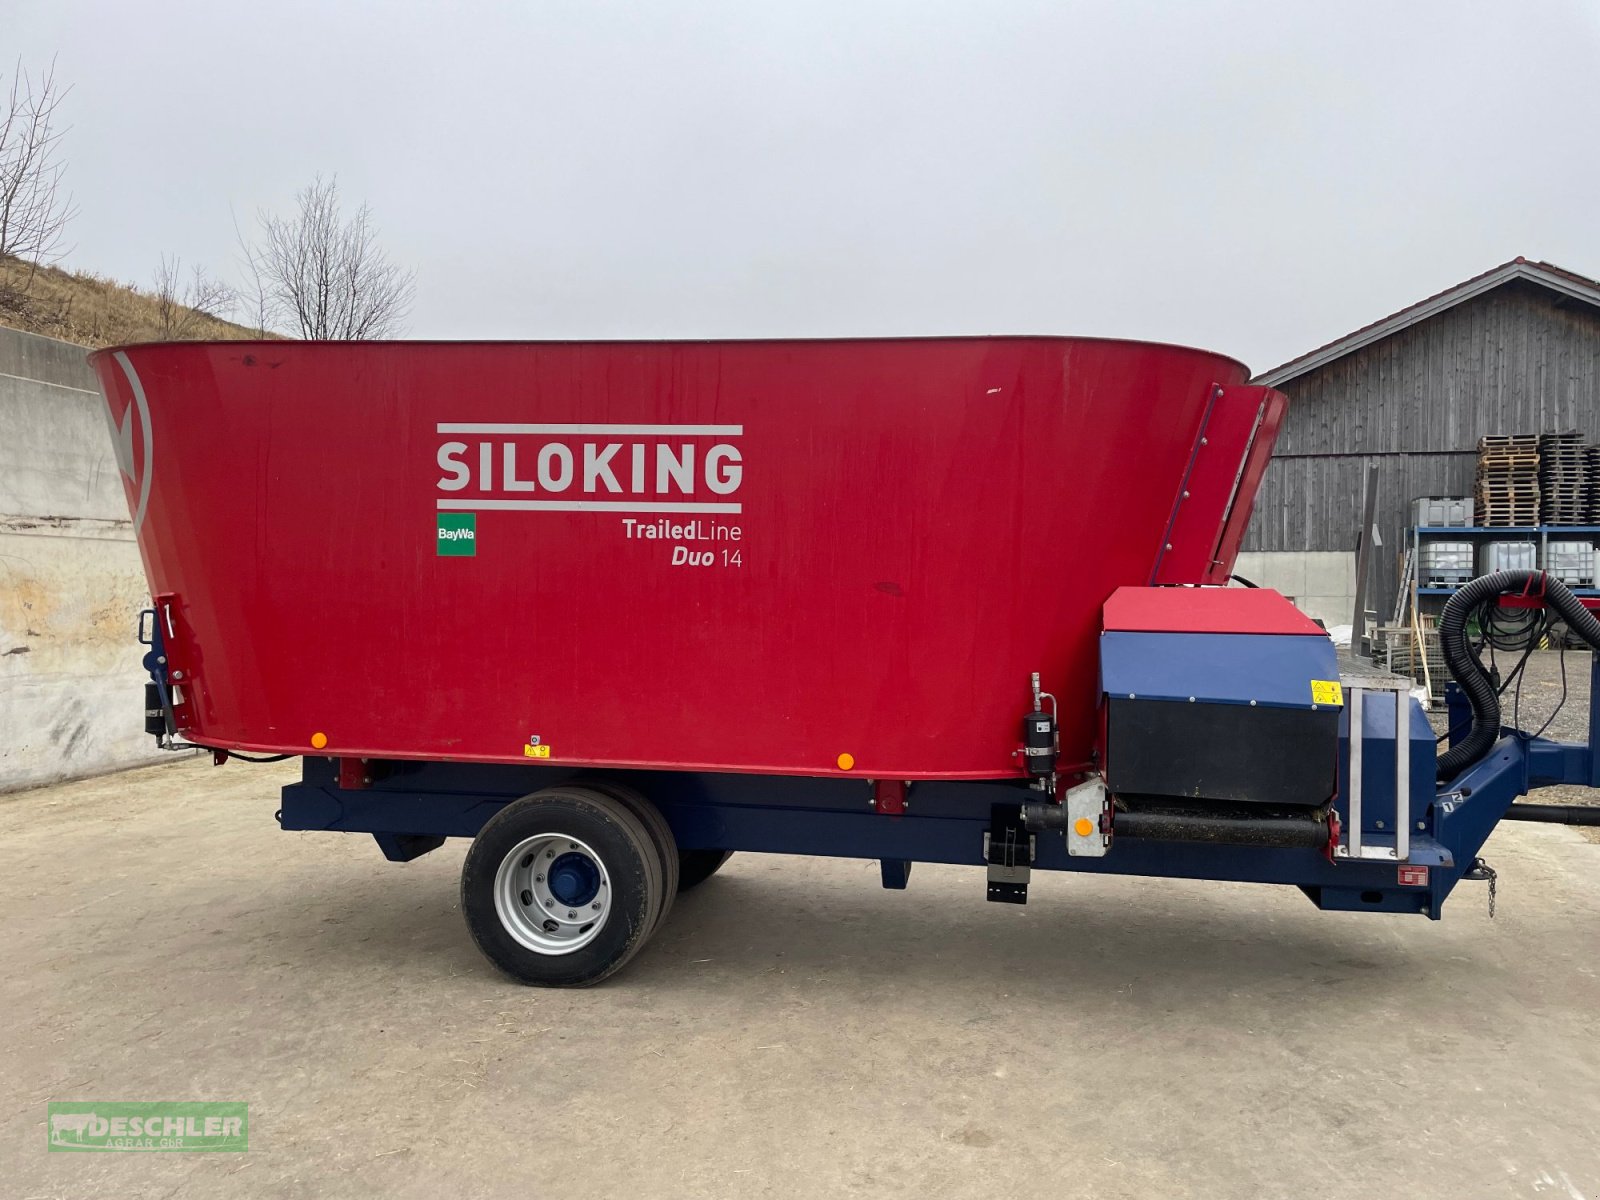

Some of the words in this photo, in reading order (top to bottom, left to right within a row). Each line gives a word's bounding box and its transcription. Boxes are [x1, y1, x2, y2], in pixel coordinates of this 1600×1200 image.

[436, 441, 743, 495] SILOKING
[438, 528, 475, 542] BayWa
[622, 518, 742, 541] TrailedLine
[671, 546, 715, 567] Duo
[721, 549, 743, 568] 14
